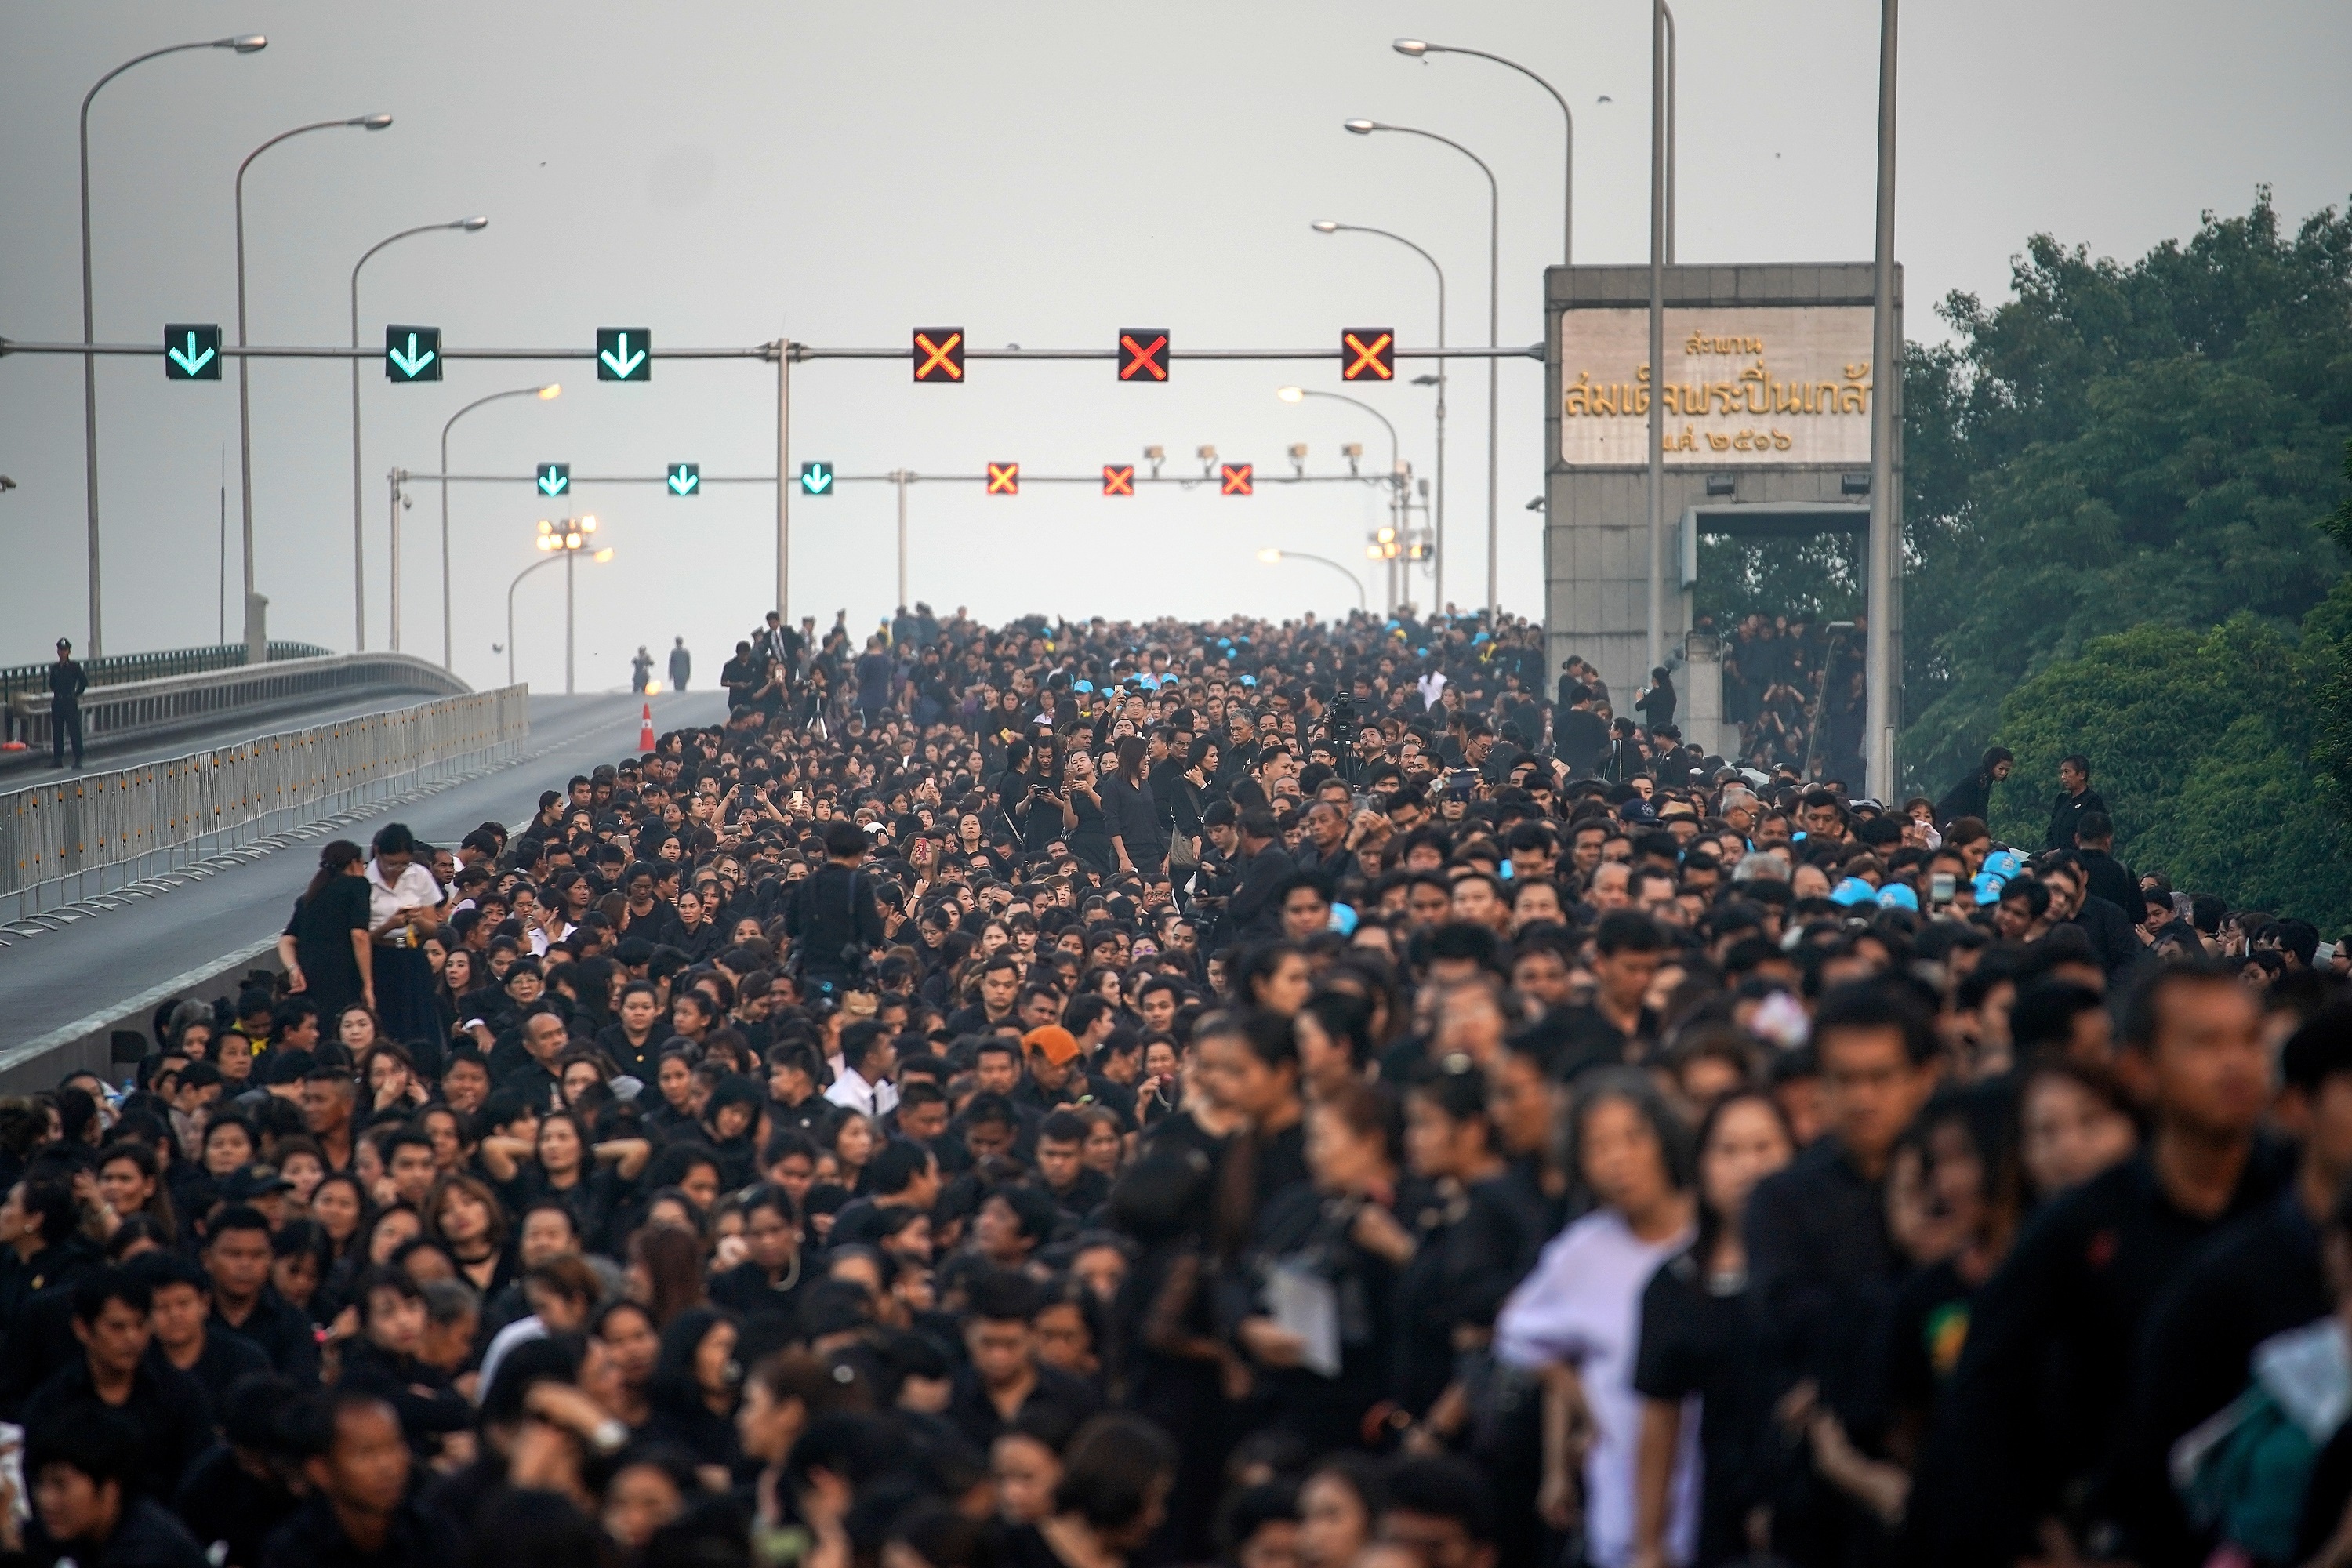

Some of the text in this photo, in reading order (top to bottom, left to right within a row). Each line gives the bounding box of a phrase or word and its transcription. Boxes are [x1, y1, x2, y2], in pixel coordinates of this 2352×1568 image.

[1686, 329, 1762, 355] สะพาน
[1566, 359, 1873, 417] สมเด็จพระปิ่นเกล้
[1705, 427, 1793, 452] ๒๕๑๖
